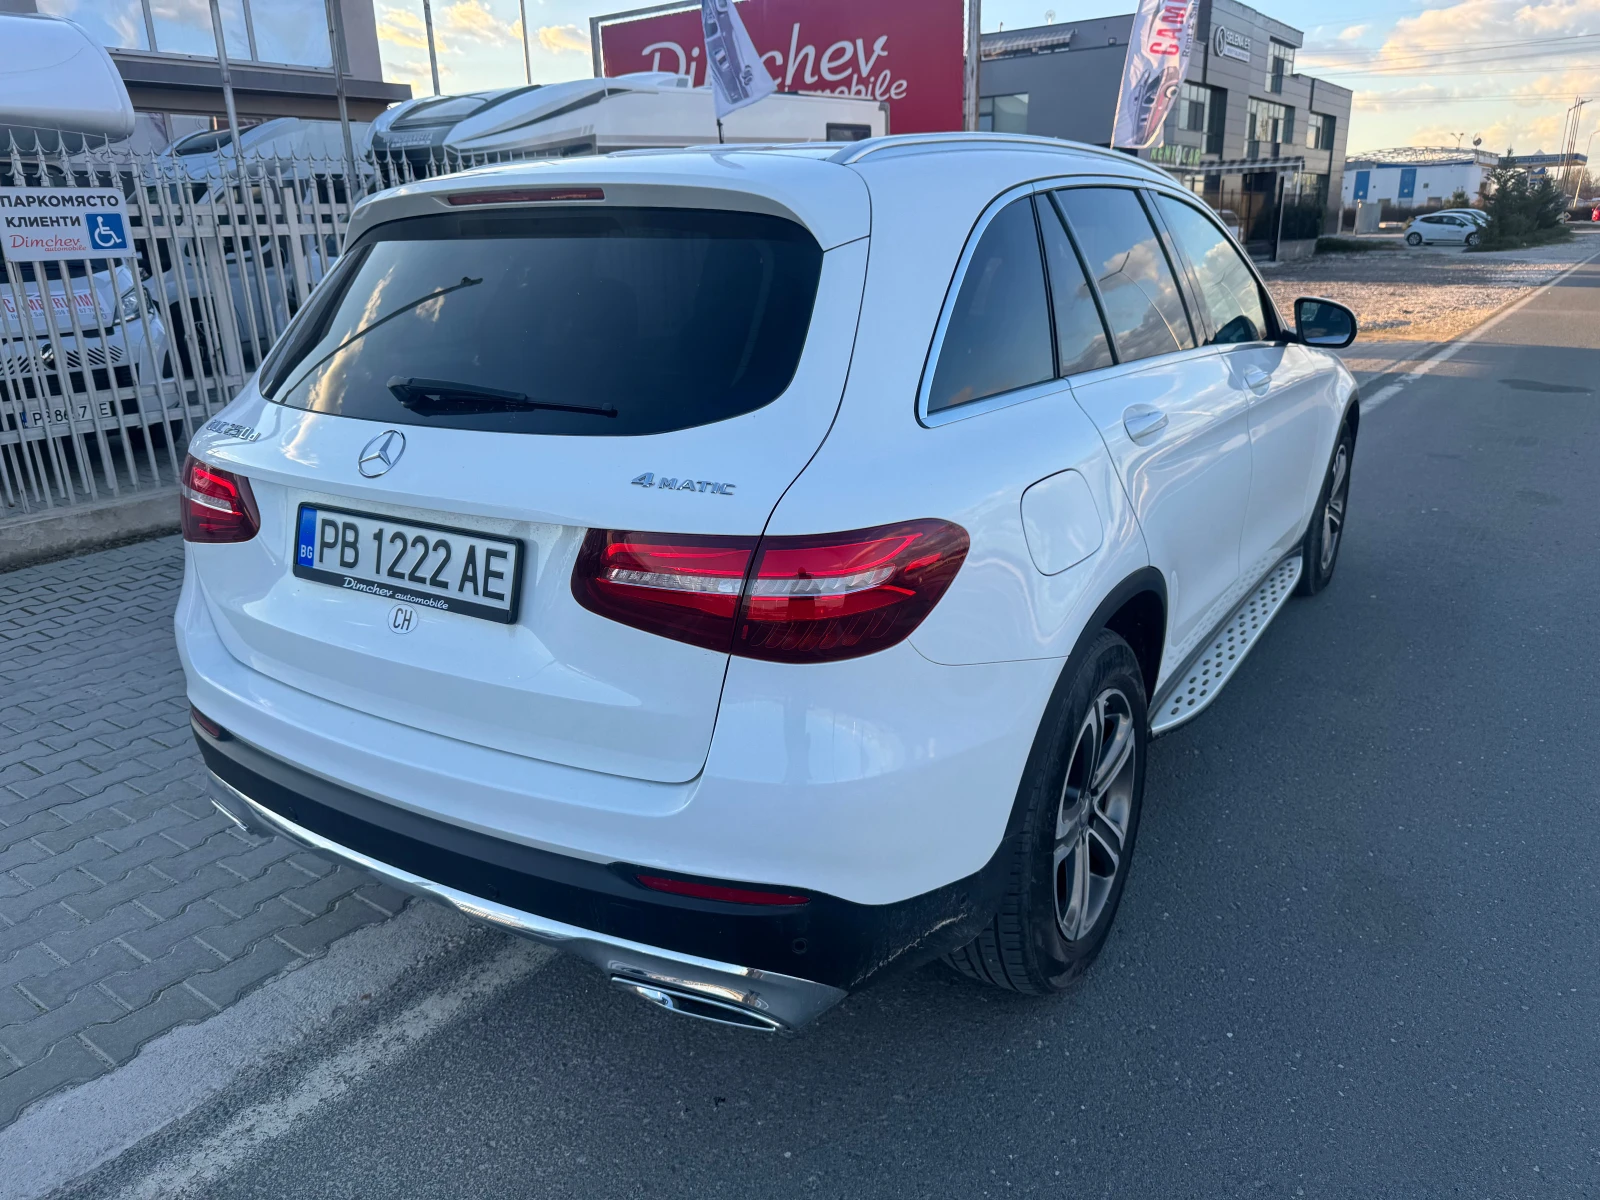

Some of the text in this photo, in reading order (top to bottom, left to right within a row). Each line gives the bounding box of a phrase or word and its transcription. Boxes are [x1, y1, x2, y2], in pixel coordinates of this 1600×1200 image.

[1149, 0, 1188, 56] CAM
[641, 22, 888, 92] Dichev
[0, 194, 119, 208] ПАРКОМЯСТО
[5, 215, 82, 228] КЛИЕНТИ
[9, 234, 81, 249] Dimchev
[300, 544, 314, 559] BG
[319, 518, 509, 601] PB 1222 AE
[343, 577, 450, 611] Dimchev automobile
[393, 608, 414, 631] CH
